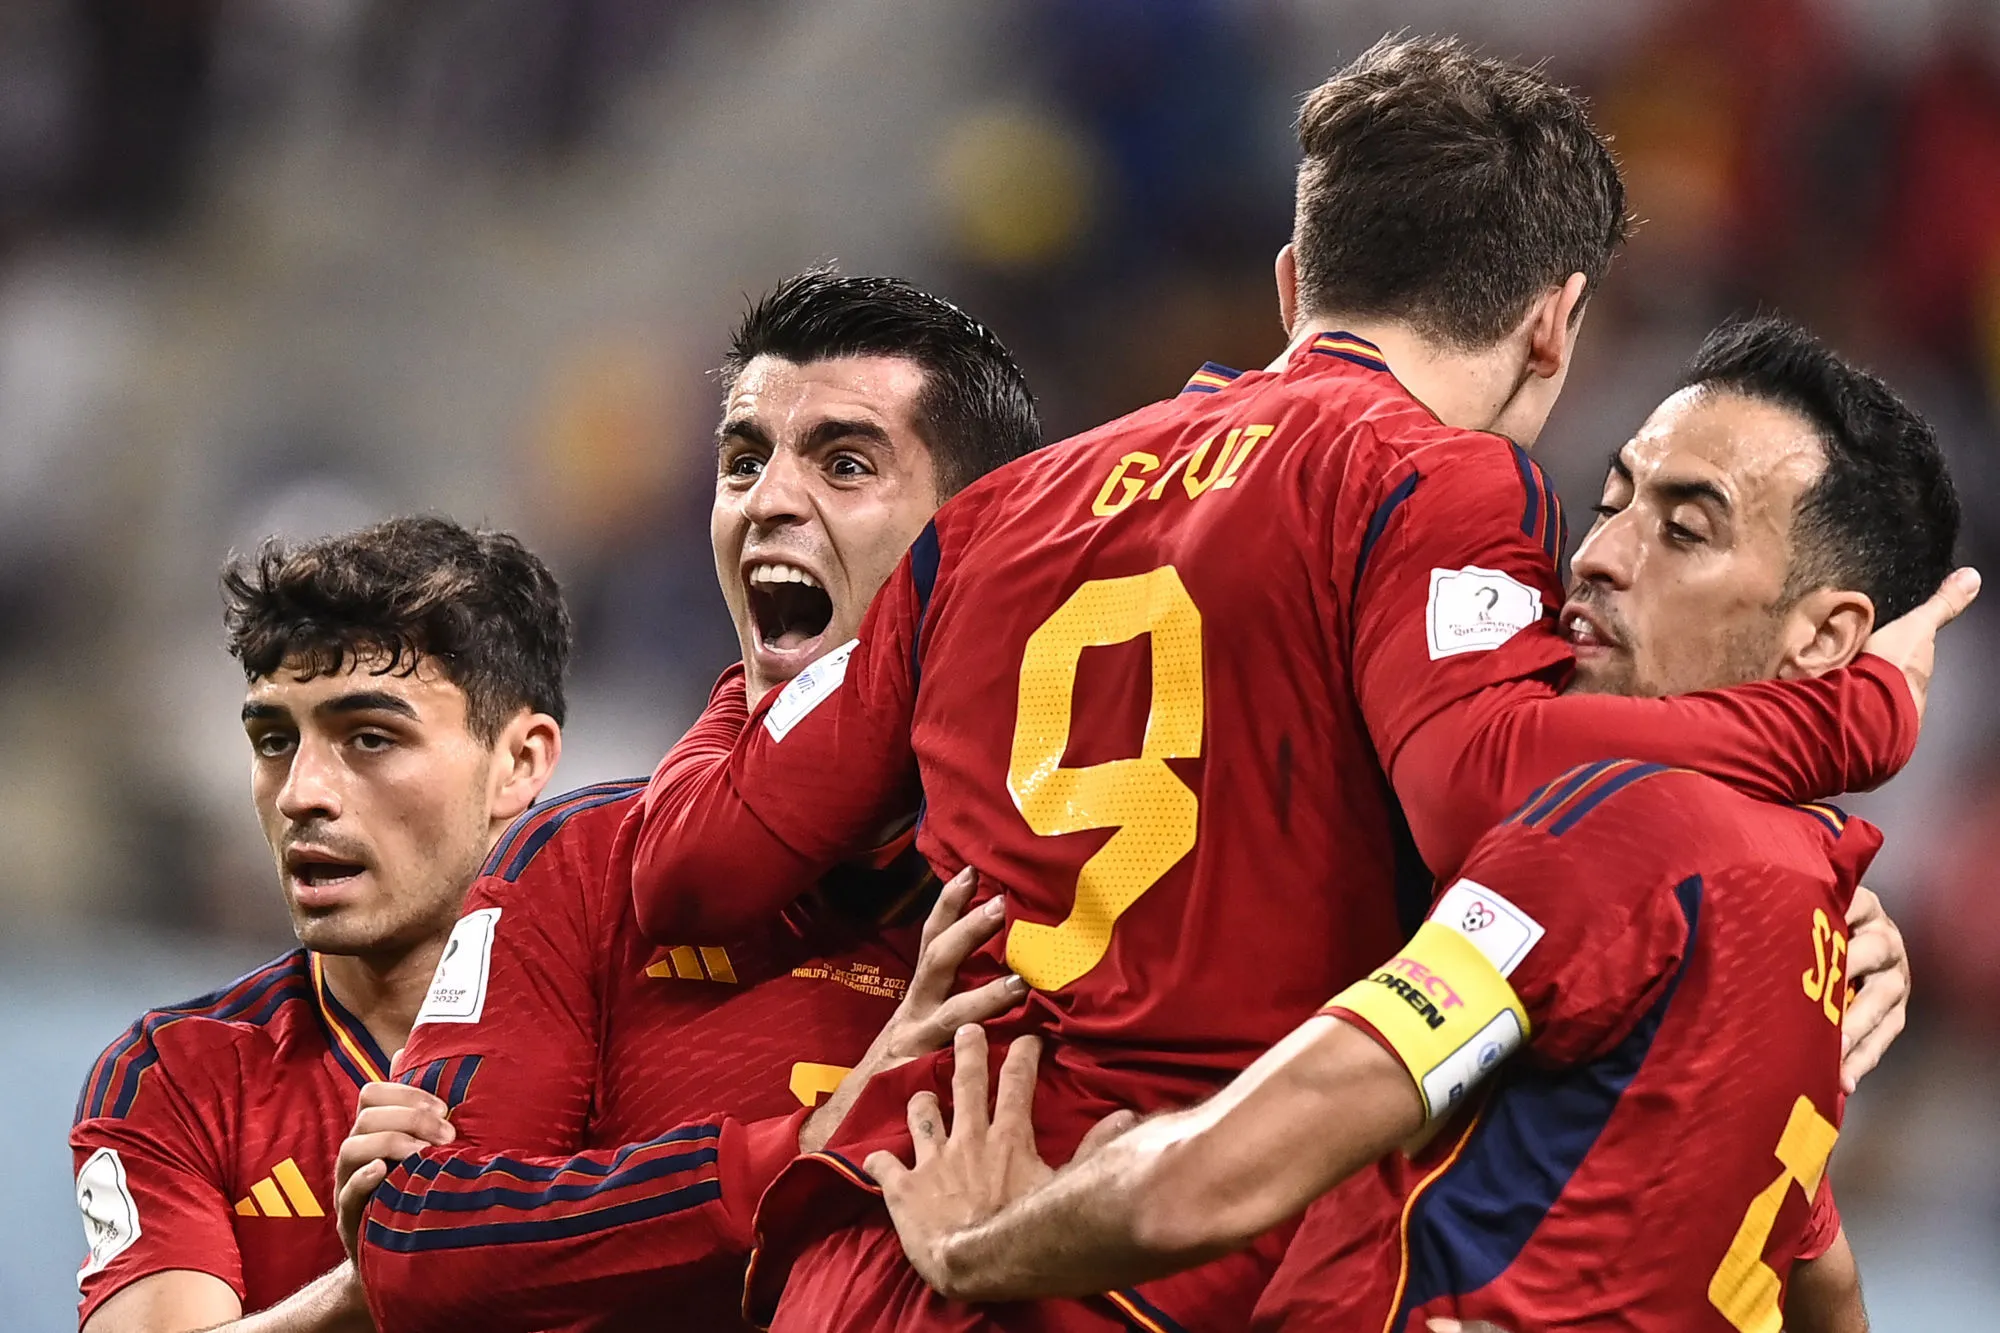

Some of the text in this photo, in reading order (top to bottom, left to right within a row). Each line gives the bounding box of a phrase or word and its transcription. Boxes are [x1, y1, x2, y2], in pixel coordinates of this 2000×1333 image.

[1006, 564, 1204, 992] 9
[835, 968, 881, 986] DECEMBER
[883, 977, 906, 990] 2022
[850, 962, 880, 976] JAPAN
[792, 967, 828, 979] KHALIFA
[830, 973, 896, 999] INTERNATIONAL
